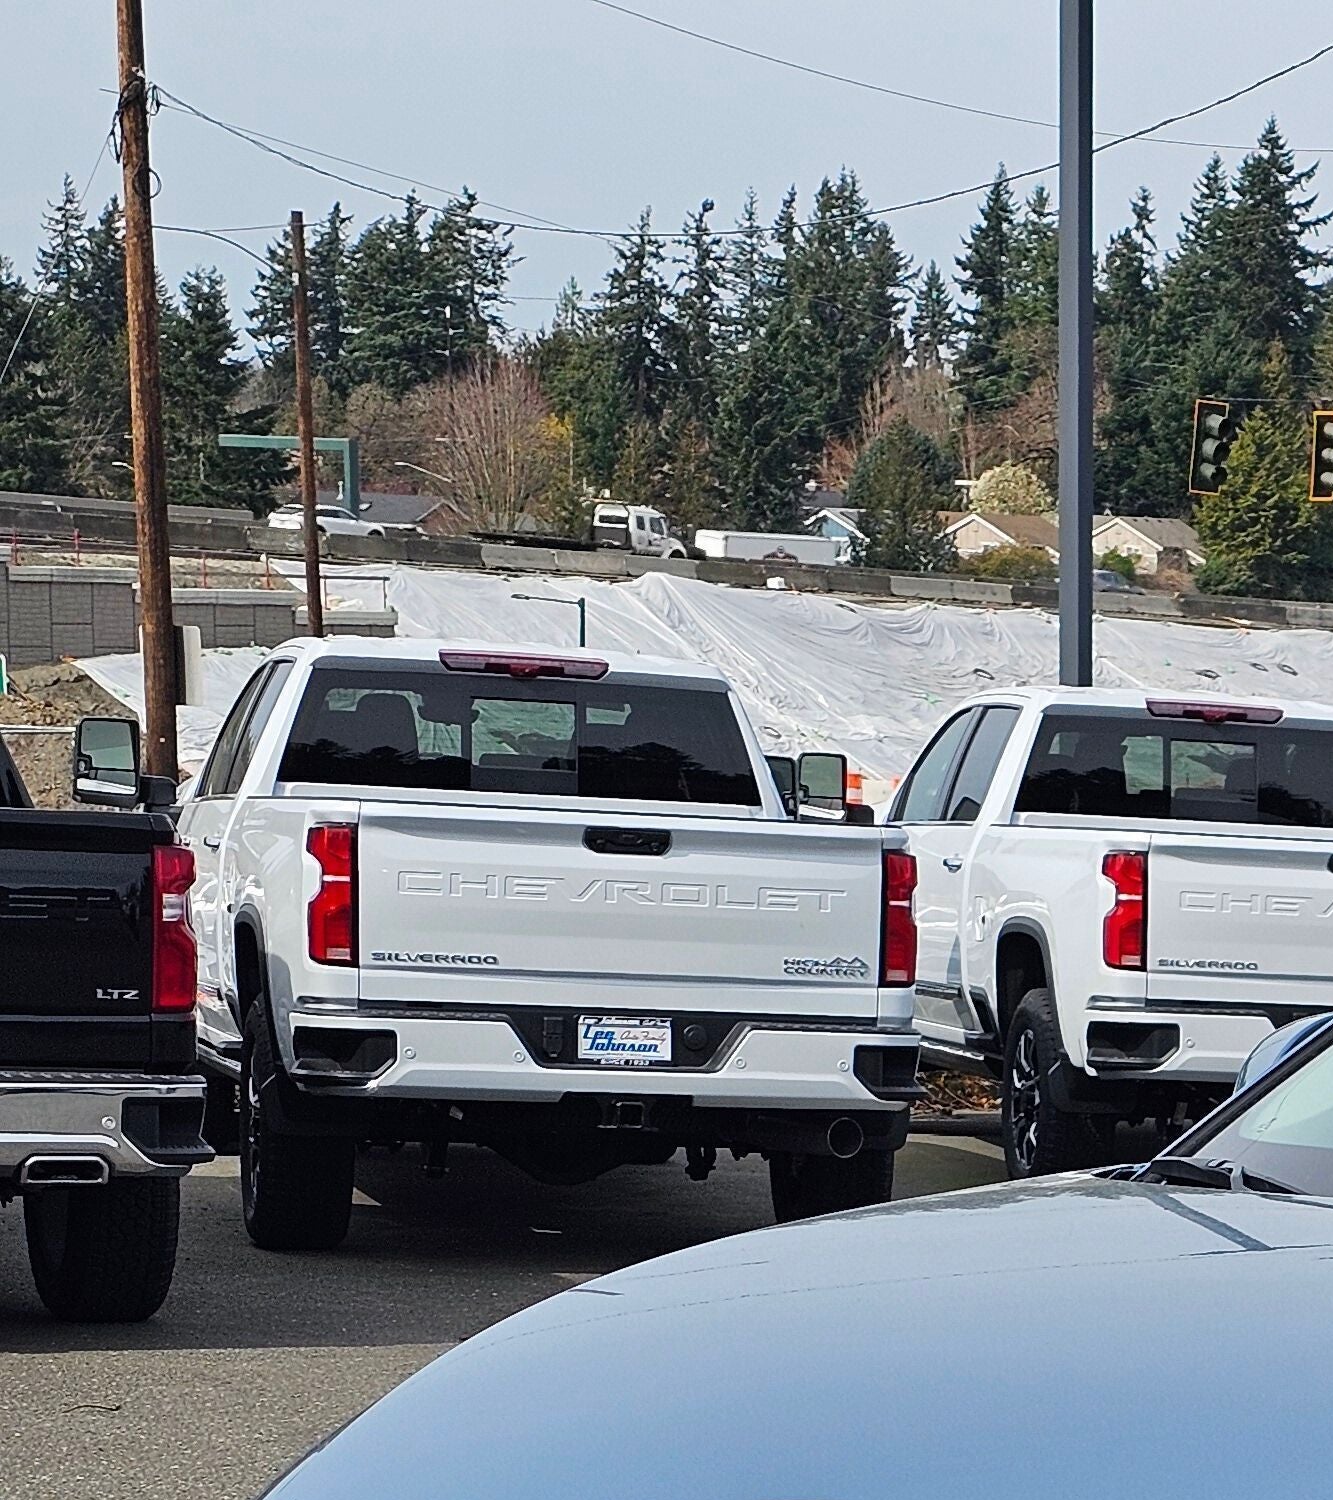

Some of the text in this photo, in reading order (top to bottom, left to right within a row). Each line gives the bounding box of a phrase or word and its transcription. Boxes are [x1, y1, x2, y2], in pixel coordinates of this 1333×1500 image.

[397, 870, 848, 913] CHEVROLET
[370, 951, 499, 967] SILVERADO
[1157, 957, 1259, 972] SILVERADO
[783, 966, 868, 977] COUNTRY
[96, 988, 140, 1000] LTZ
[583, 1023, 617, 1040] Lee
[583, 1035, 661, 1053] Johnson
